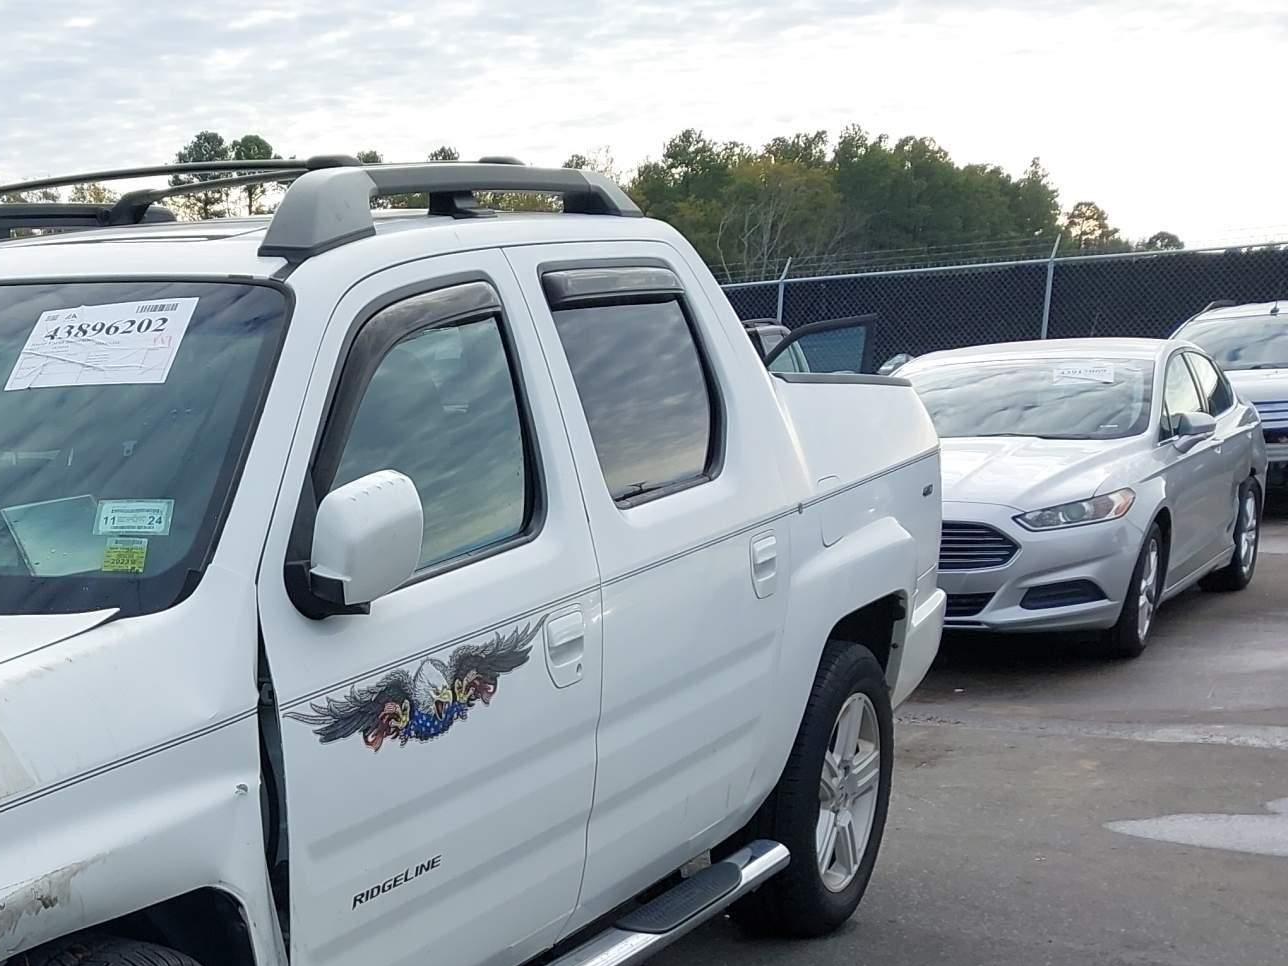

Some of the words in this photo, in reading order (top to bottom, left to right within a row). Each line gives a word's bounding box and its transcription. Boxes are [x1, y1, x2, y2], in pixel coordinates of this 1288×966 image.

[44, 316, 170, 341] 43896202
[103, 515, 116, 526] 11
[147, 515, 163, 526] 24
[351, 854, 442, 911] RIDGELINE
